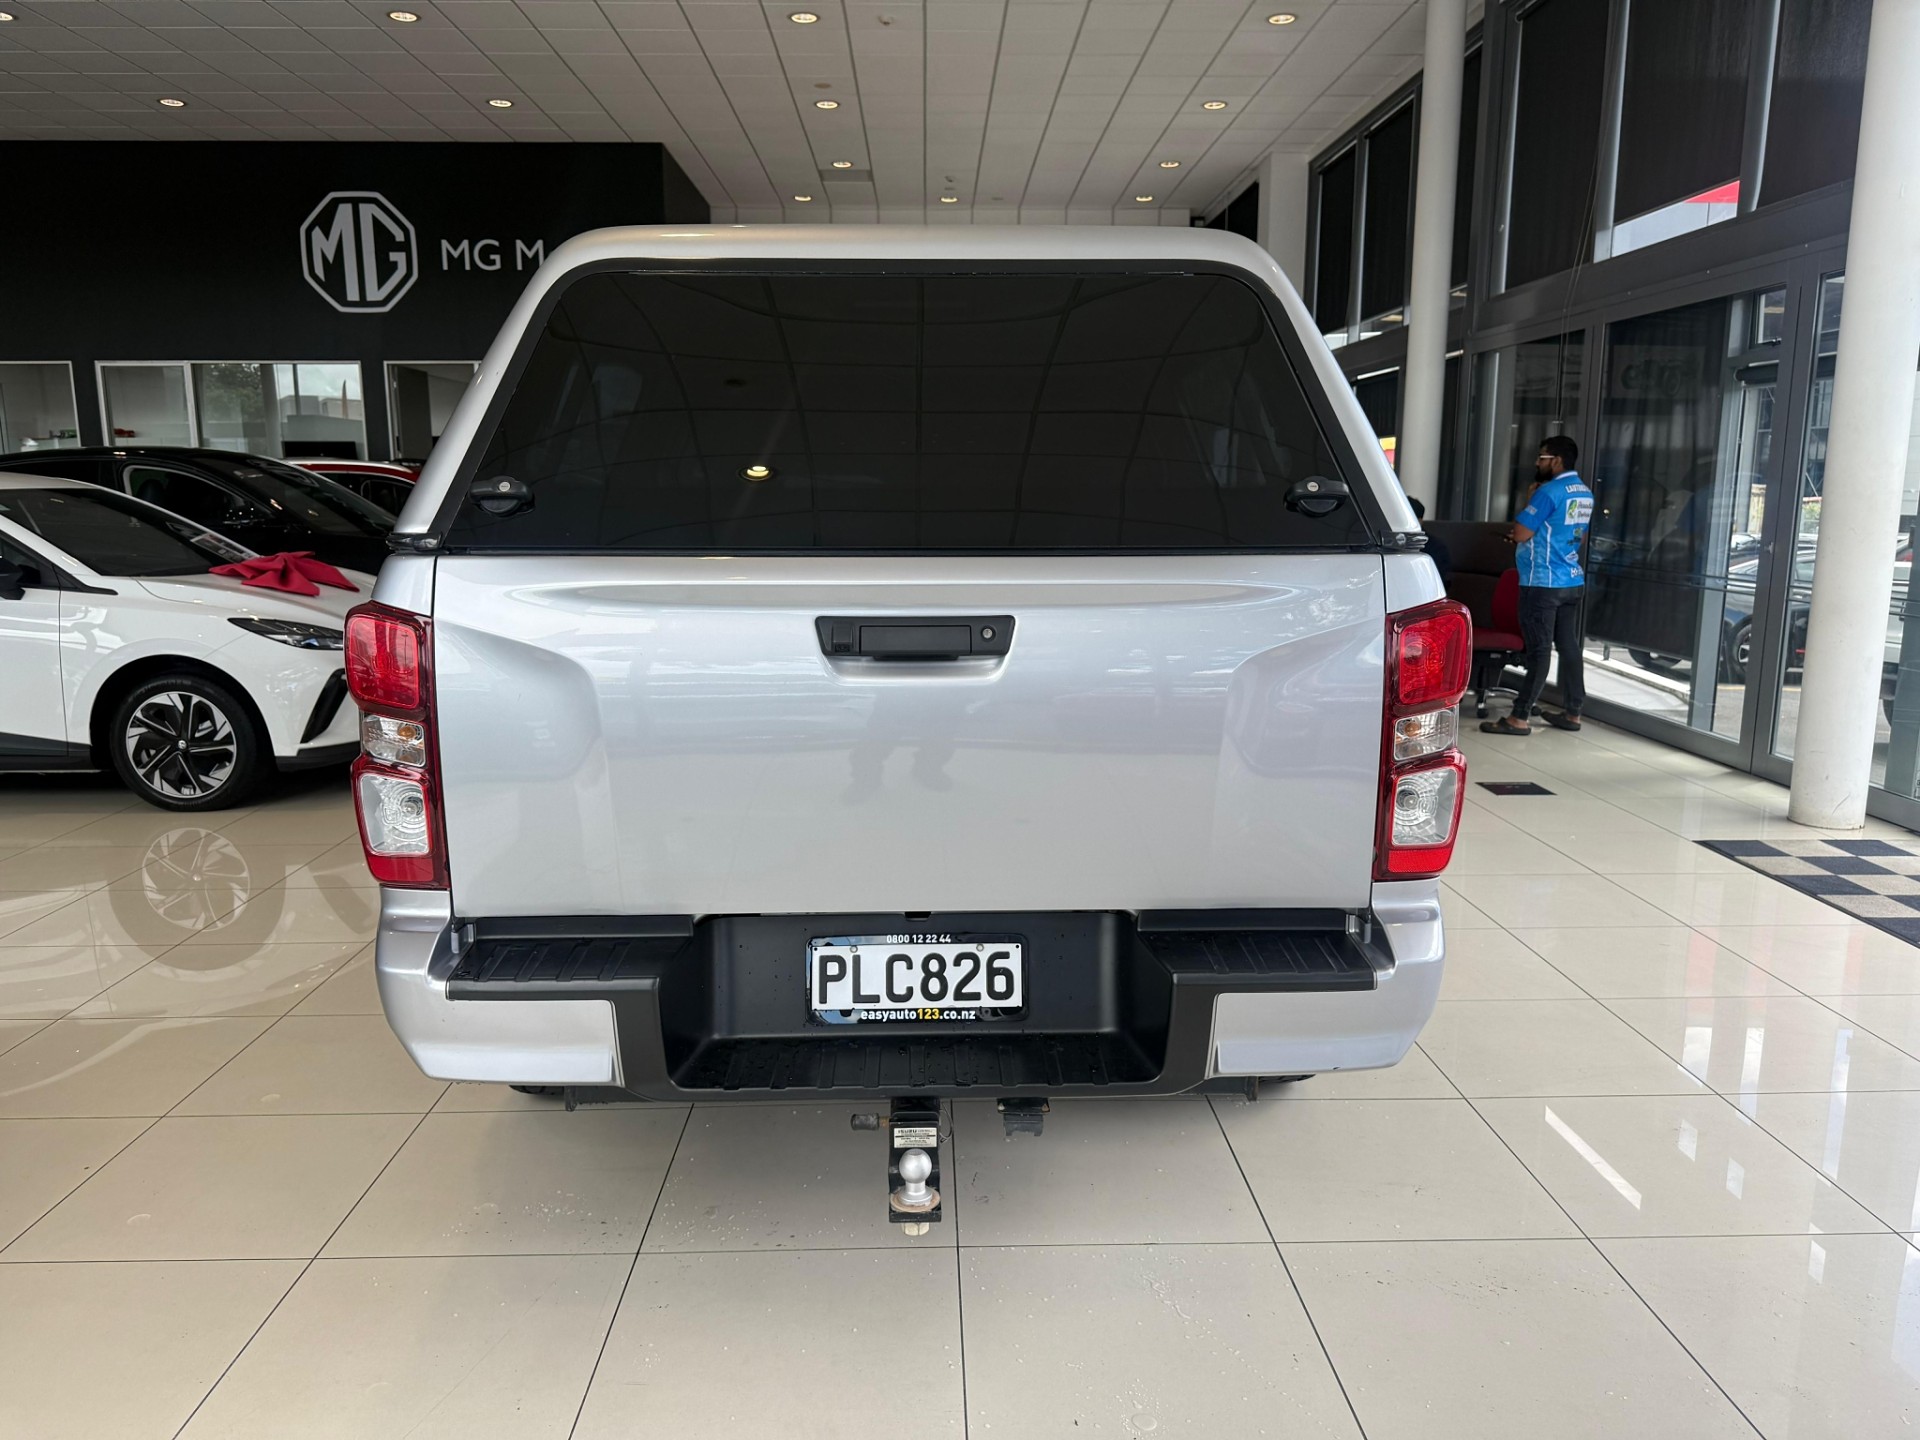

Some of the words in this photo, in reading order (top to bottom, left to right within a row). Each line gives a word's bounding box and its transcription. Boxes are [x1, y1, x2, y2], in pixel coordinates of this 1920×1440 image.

[311, 203, 407, 302] MG
[440, 239, 502, 271] MG
[886, 934, 910, 944] 0800
[912, 934, 924, 943] 12
[925, 934, 938, 943] 22
[939, 934, 952, 943] 44
[818, 951, 1015, 1005] PLC826
[860, 1008, 976, 1022] easyauto123.co.nz
